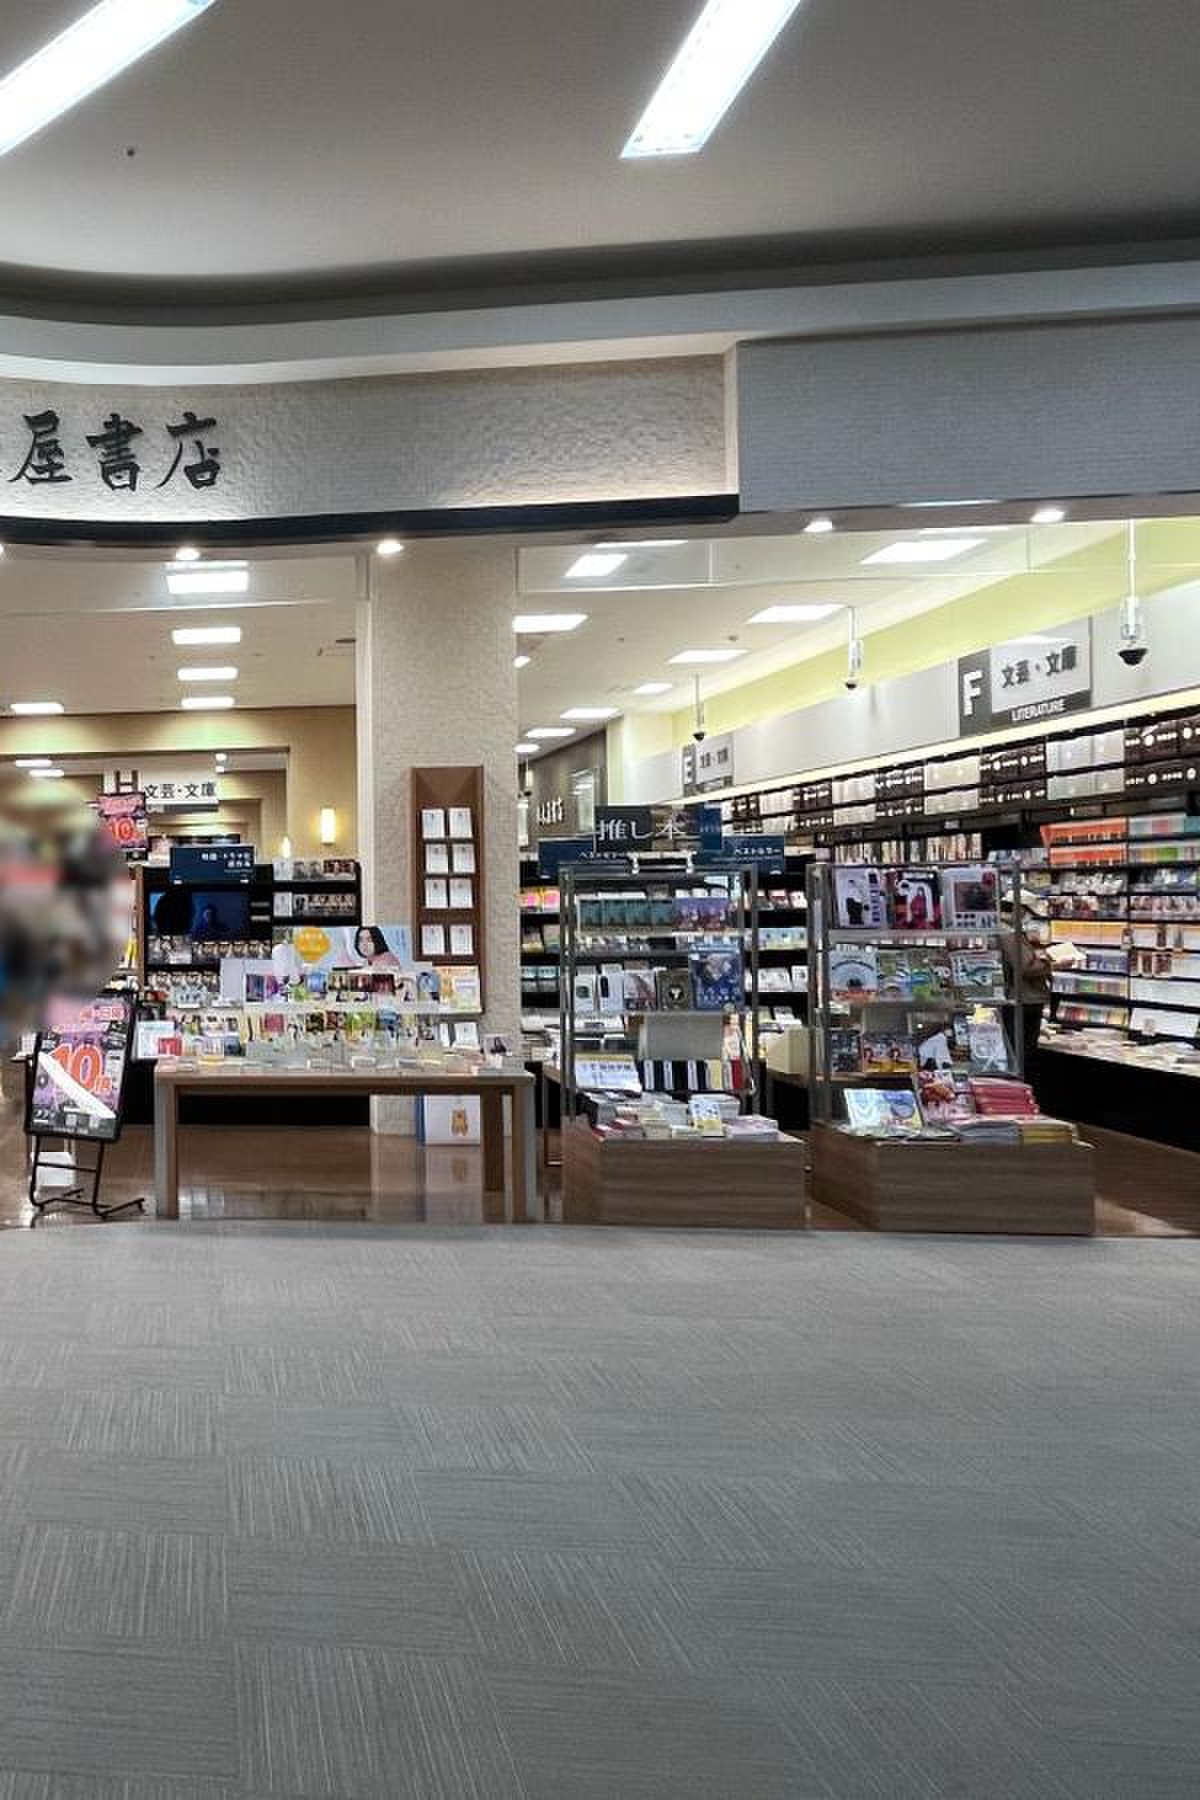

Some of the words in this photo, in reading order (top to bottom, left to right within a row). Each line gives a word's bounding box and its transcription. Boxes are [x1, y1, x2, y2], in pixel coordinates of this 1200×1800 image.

[1001, 645, 1077, 688] 文芸・文庫
[963, 670, 983, 716] F
[1011, 699, 1065, 721] LITERATURE
[145, 782, 216, 799] 文芸・文庫
